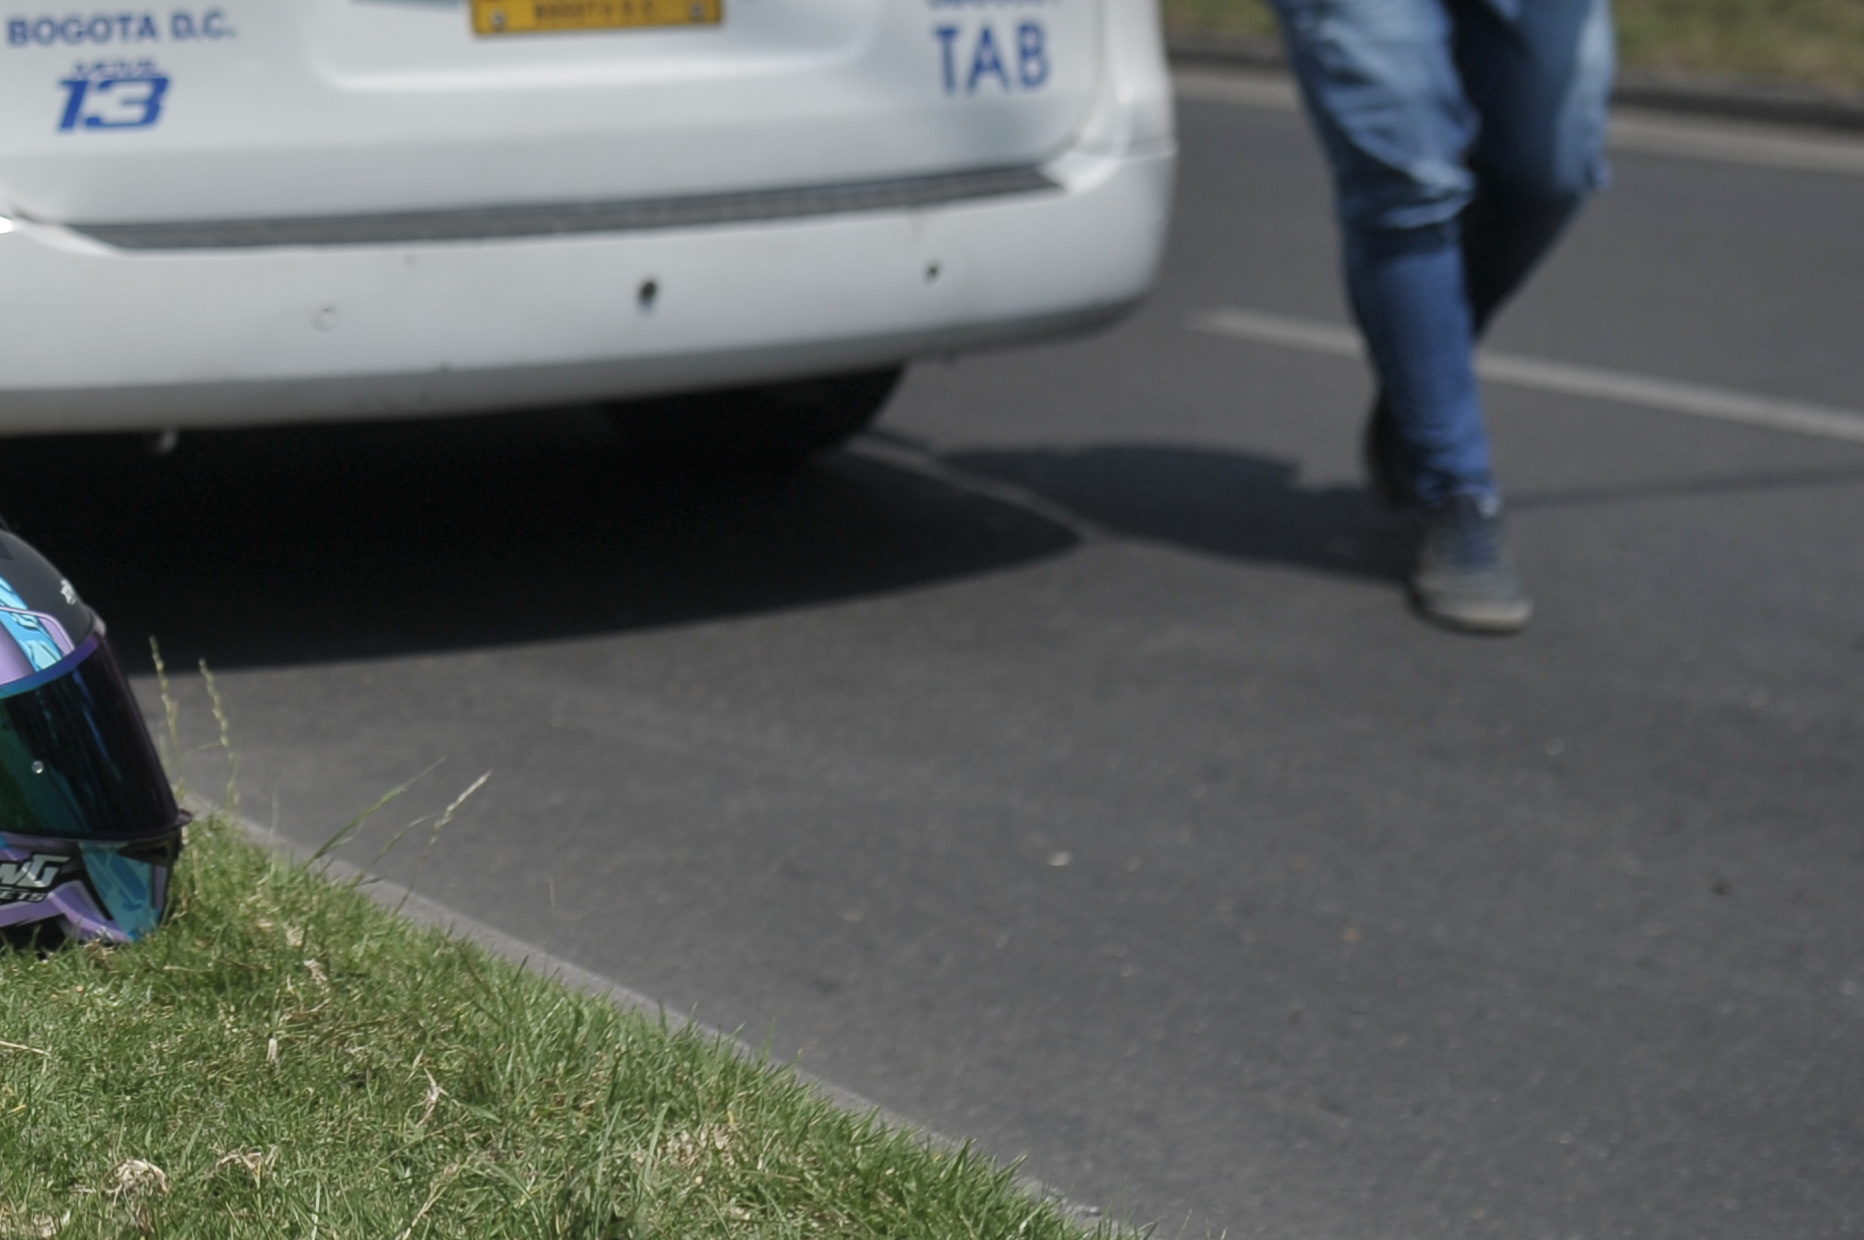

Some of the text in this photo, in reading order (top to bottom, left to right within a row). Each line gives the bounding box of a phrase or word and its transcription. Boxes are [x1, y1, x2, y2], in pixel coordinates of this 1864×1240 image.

[7, 16, 156, 45] BOGOTA
[932, 24, 1050, 96] TAB
[57, 76, 169, 130] 13
